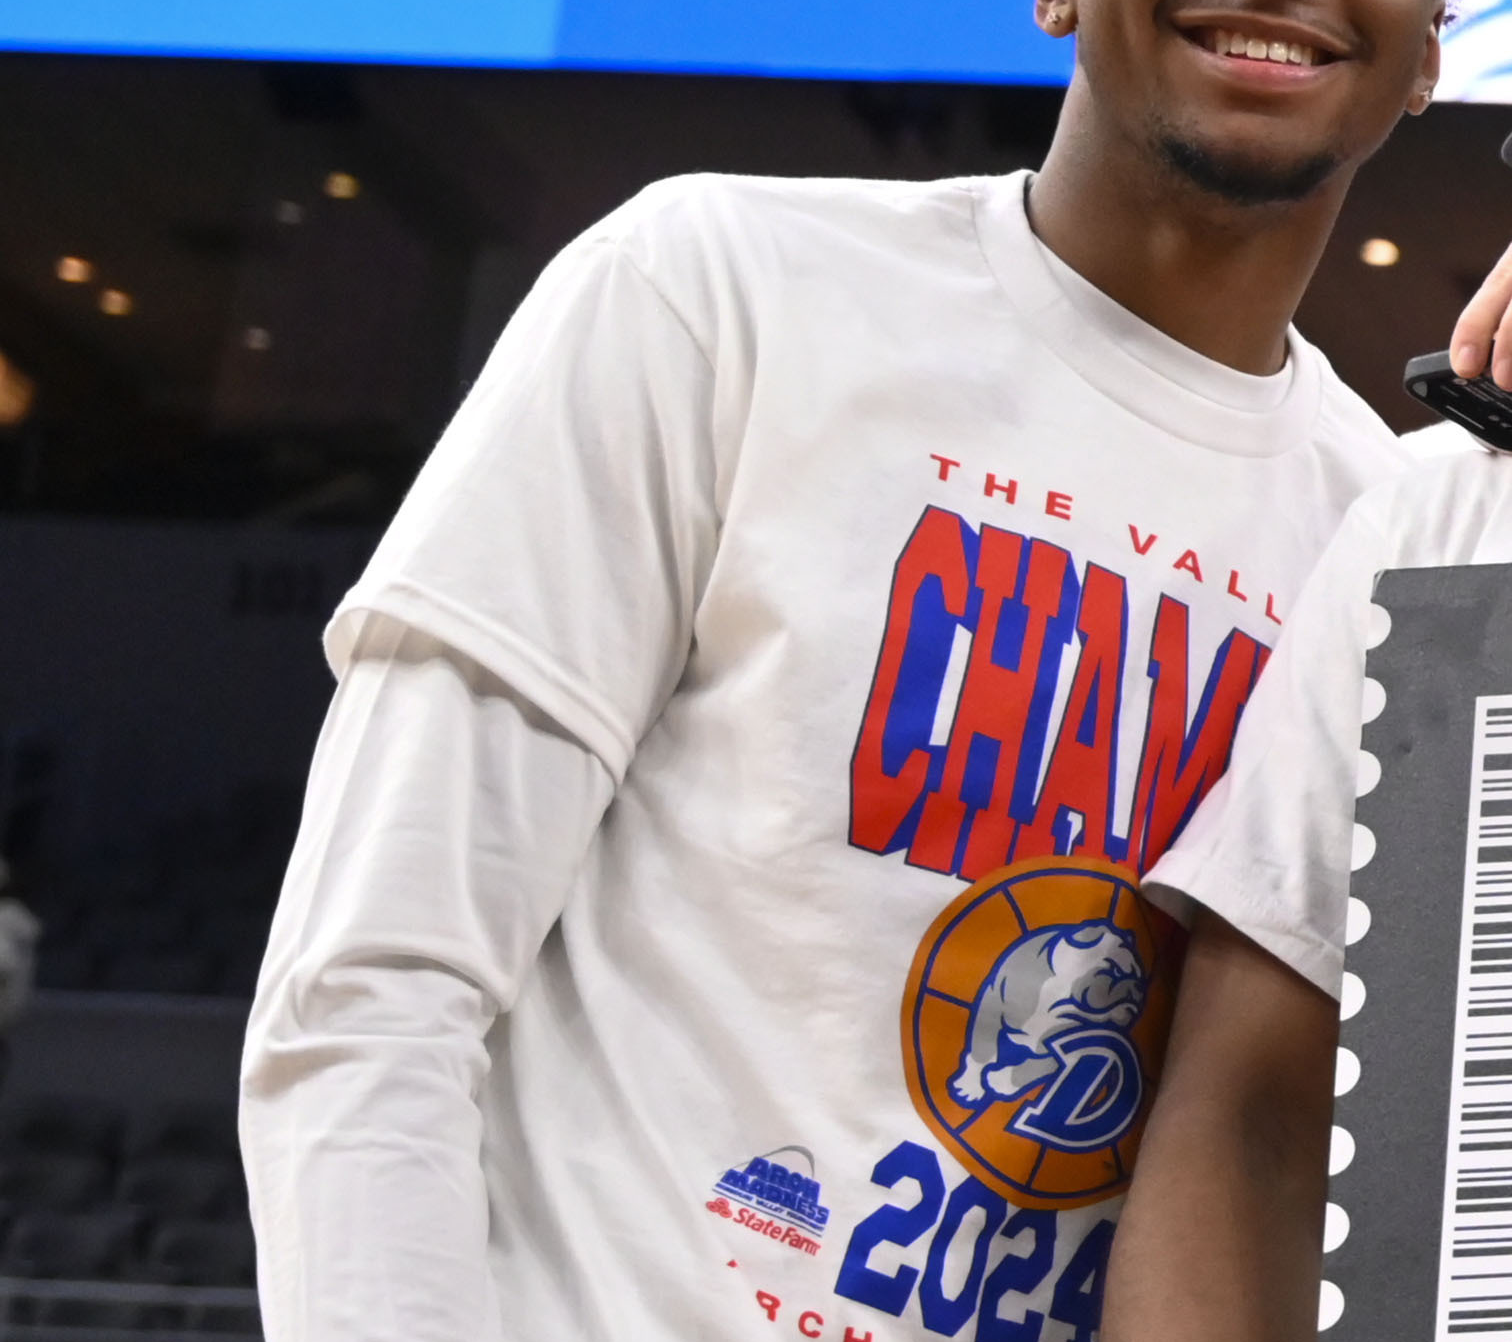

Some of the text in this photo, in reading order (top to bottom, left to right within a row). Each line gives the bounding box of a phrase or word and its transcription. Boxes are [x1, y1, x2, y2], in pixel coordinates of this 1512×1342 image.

[930, 454, 1283, 626] THE VALL
[848, 504, 1272, 883] CHAM
